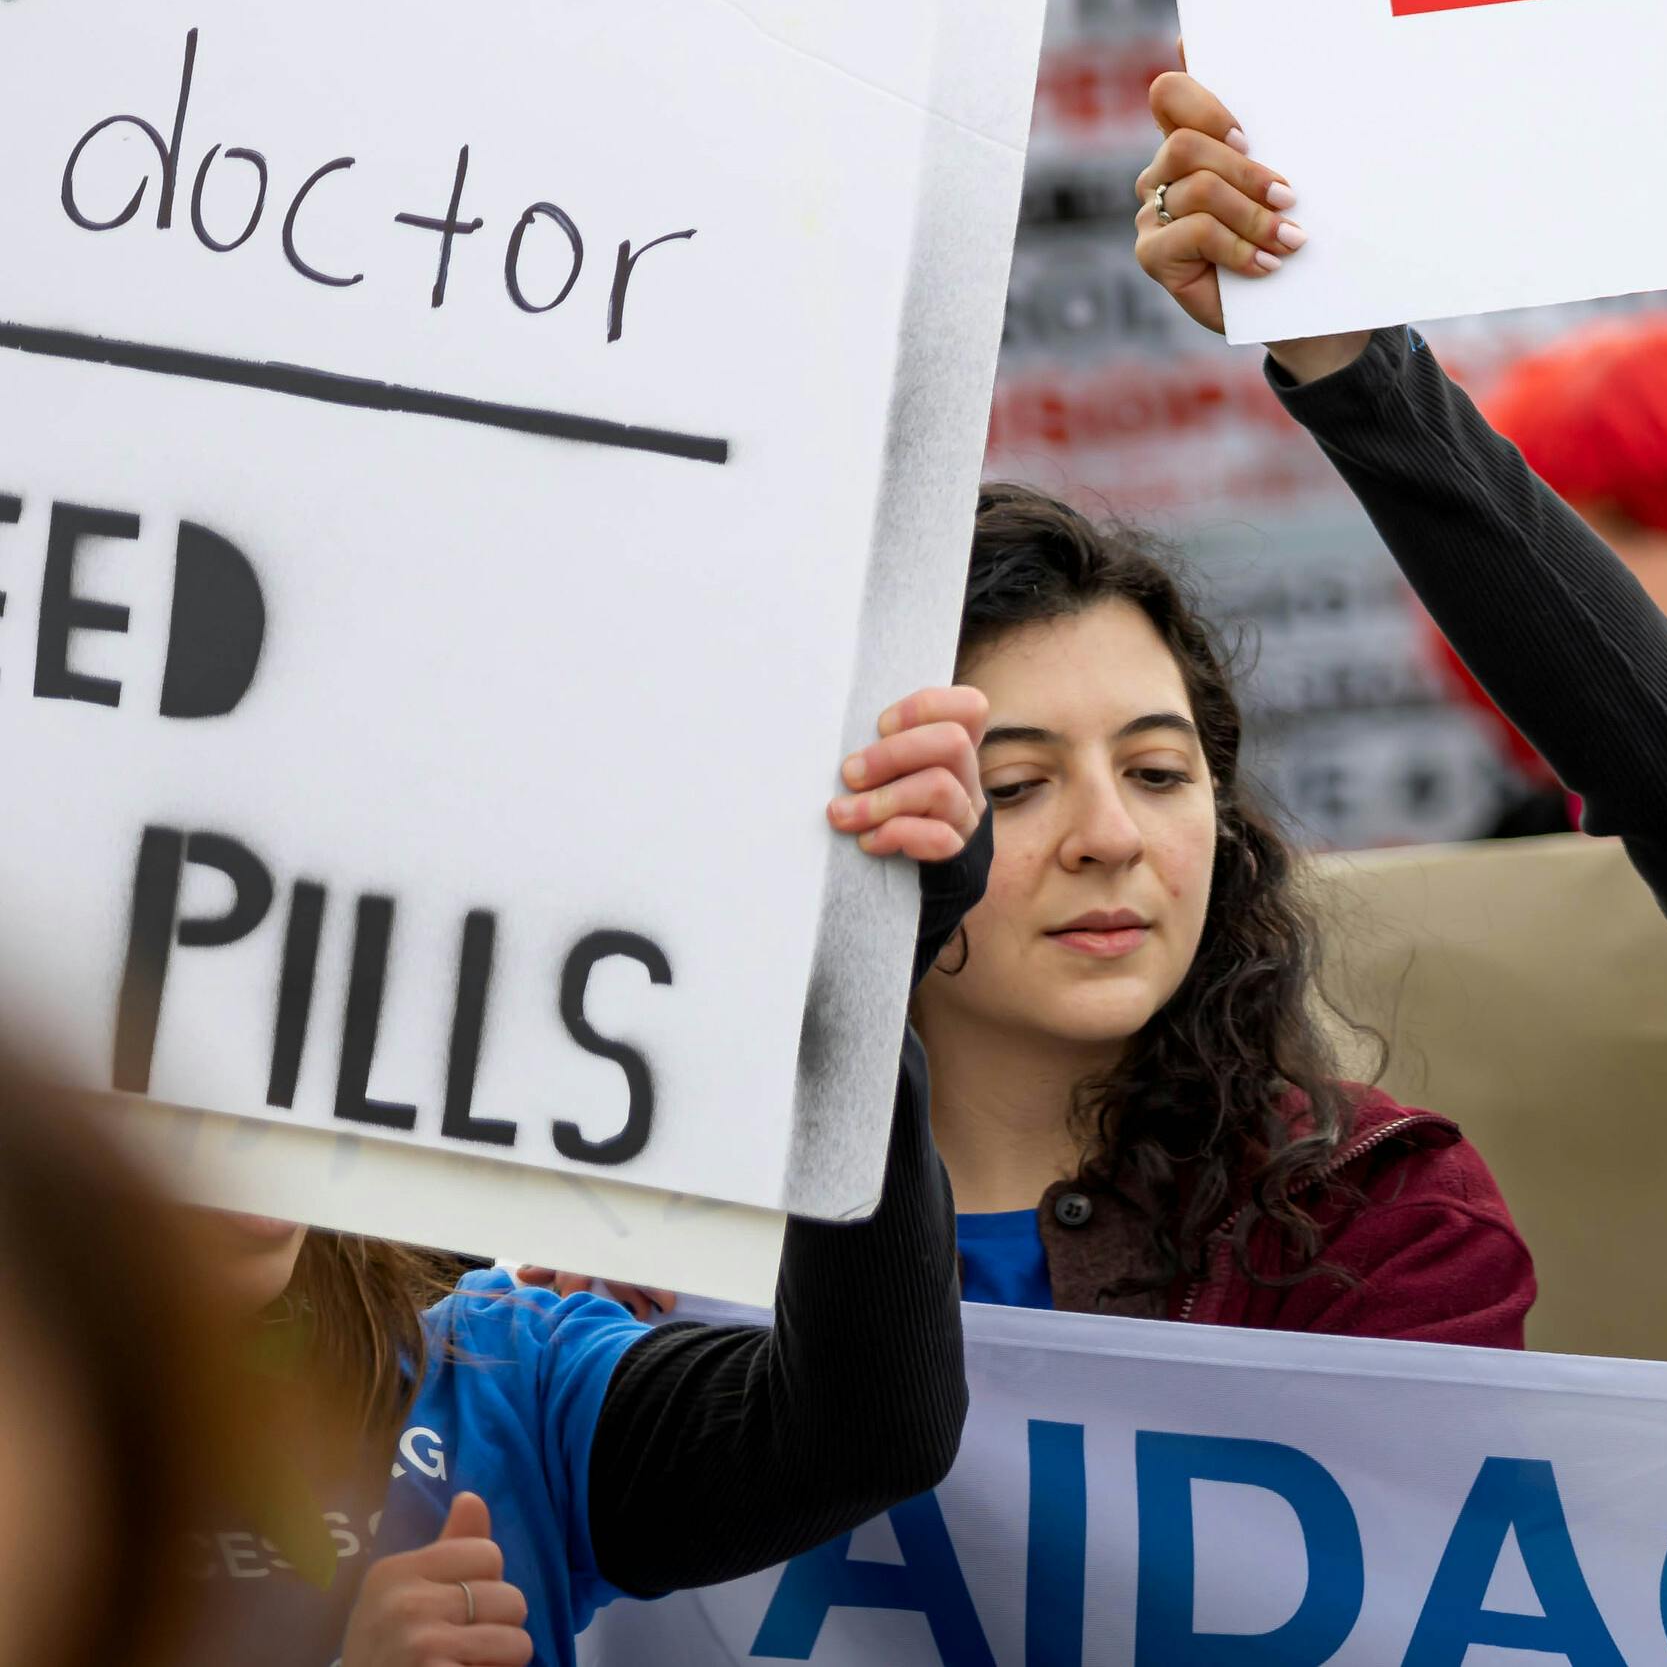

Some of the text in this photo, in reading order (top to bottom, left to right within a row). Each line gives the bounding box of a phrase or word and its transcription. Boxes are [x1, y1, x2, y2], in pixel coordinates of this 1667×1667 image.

[60, 27, 697, 343] doctor
[0, 492, 268, 720] ED
[112, 824, 673, 1167] PILLS
